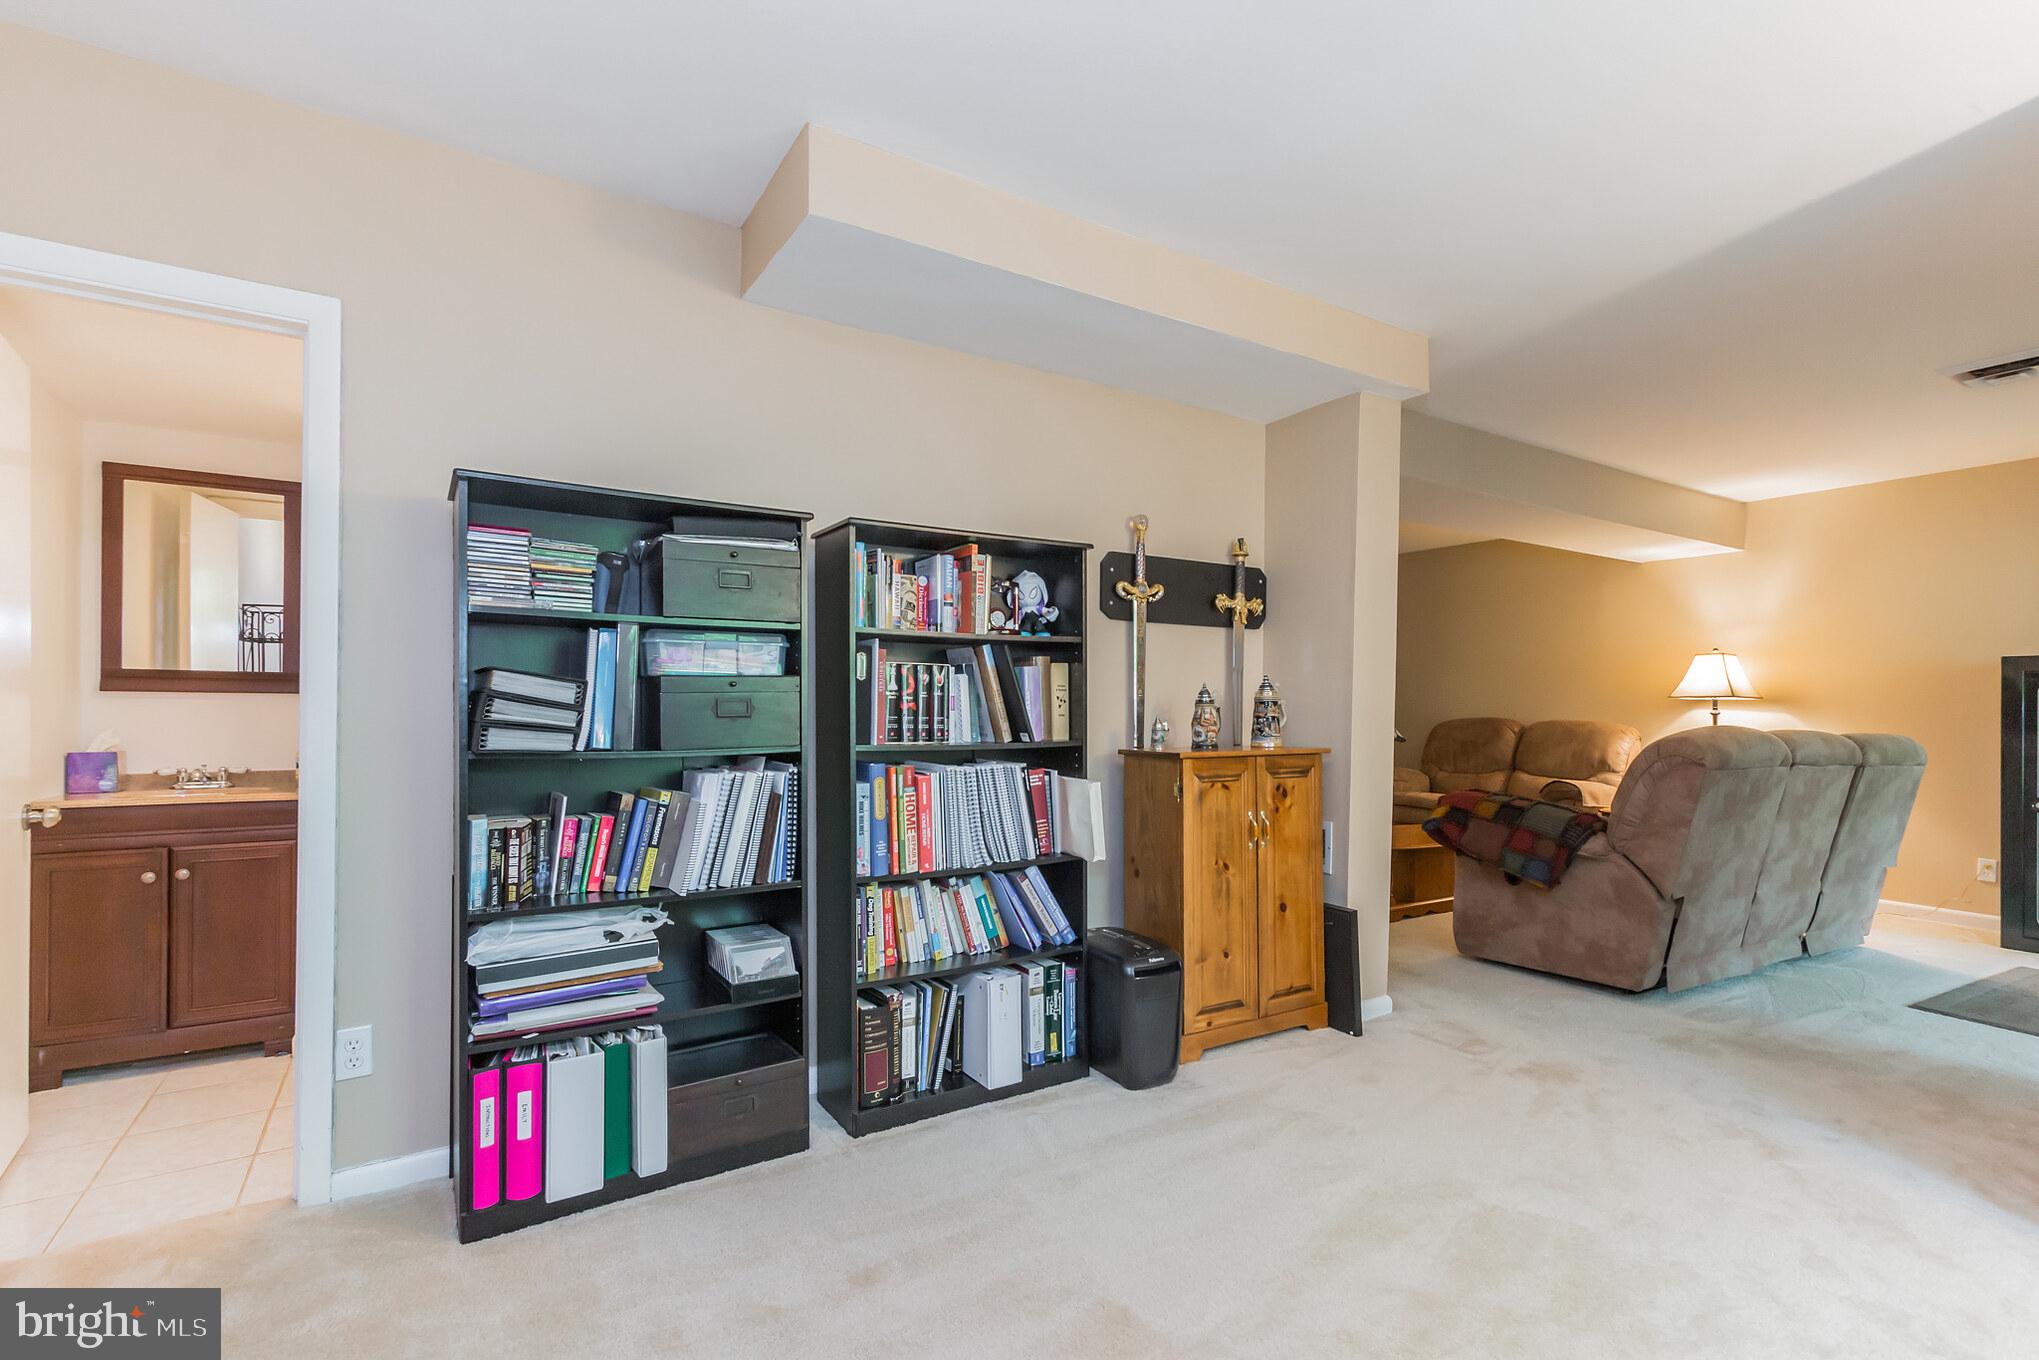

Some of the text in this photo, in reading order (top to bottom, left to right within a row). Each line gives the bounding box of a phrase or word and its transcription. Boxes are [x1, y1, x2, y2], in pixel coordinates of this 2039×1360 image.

[977, 560, 985, 595] BIBLE
[652, 806, 666, 845] Freemasons
[905, 793, 916, 834] HOME
